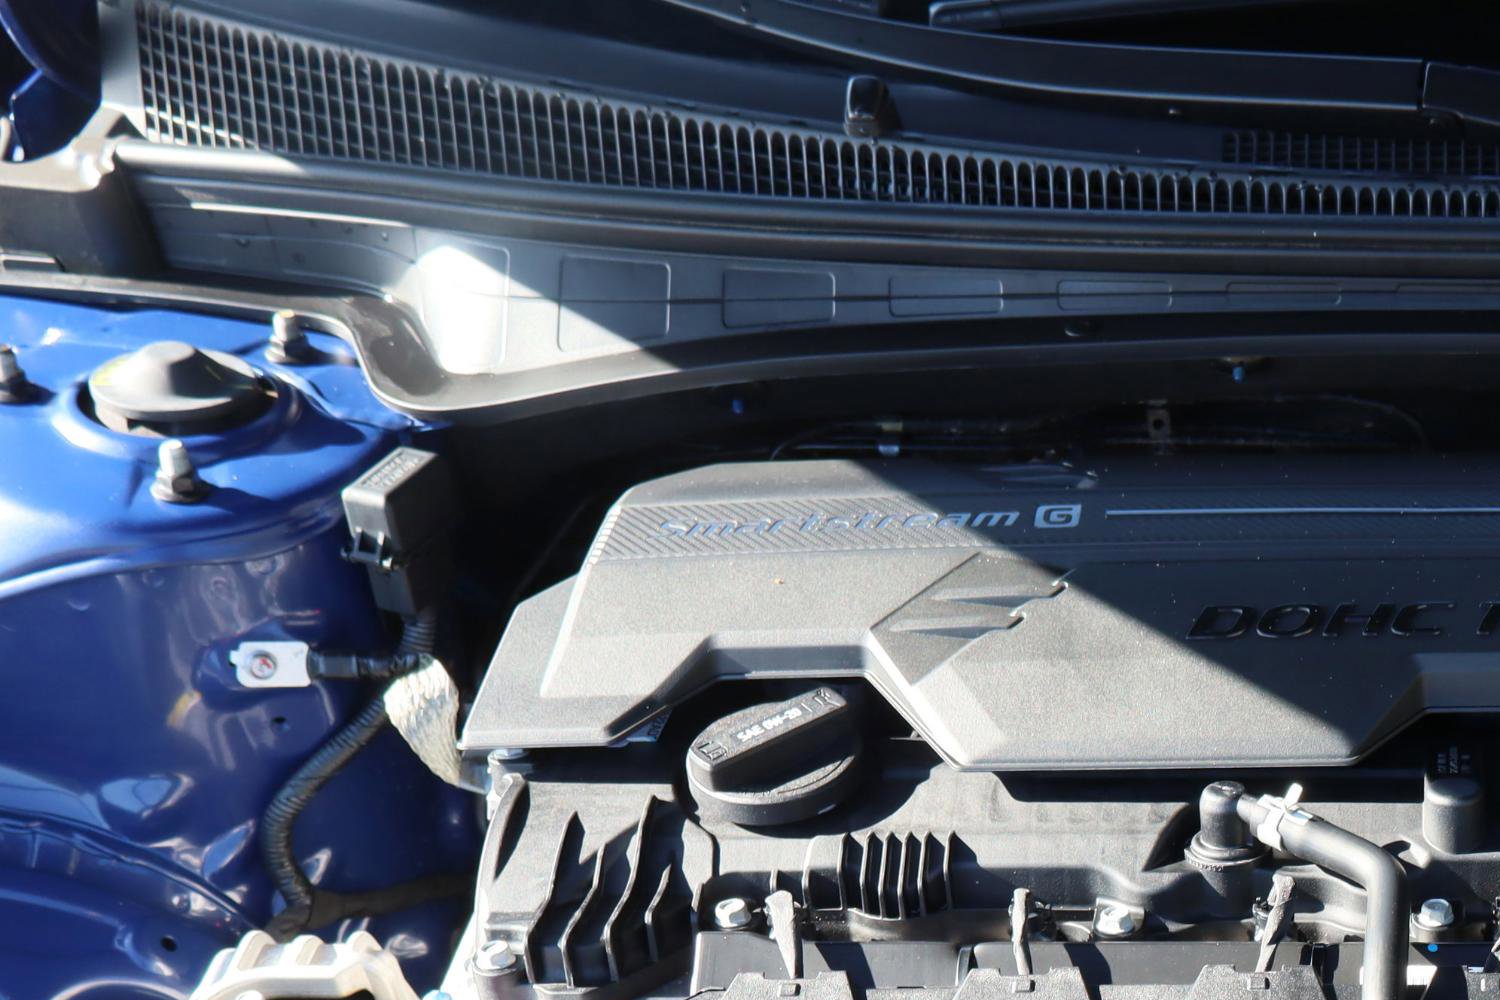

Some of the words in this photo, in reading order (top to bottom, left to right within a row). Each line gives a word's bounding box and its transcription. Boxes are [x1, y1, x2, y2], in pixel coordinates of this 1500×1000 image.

[655, 509, 1020, 538] Smartstream
[1040, 505, 1078, 527] G
[1185, 601, 1458, 640] DOHC
[737, 724, 765, 743] SAE
[762, 706, 803, 731] 0W-20
